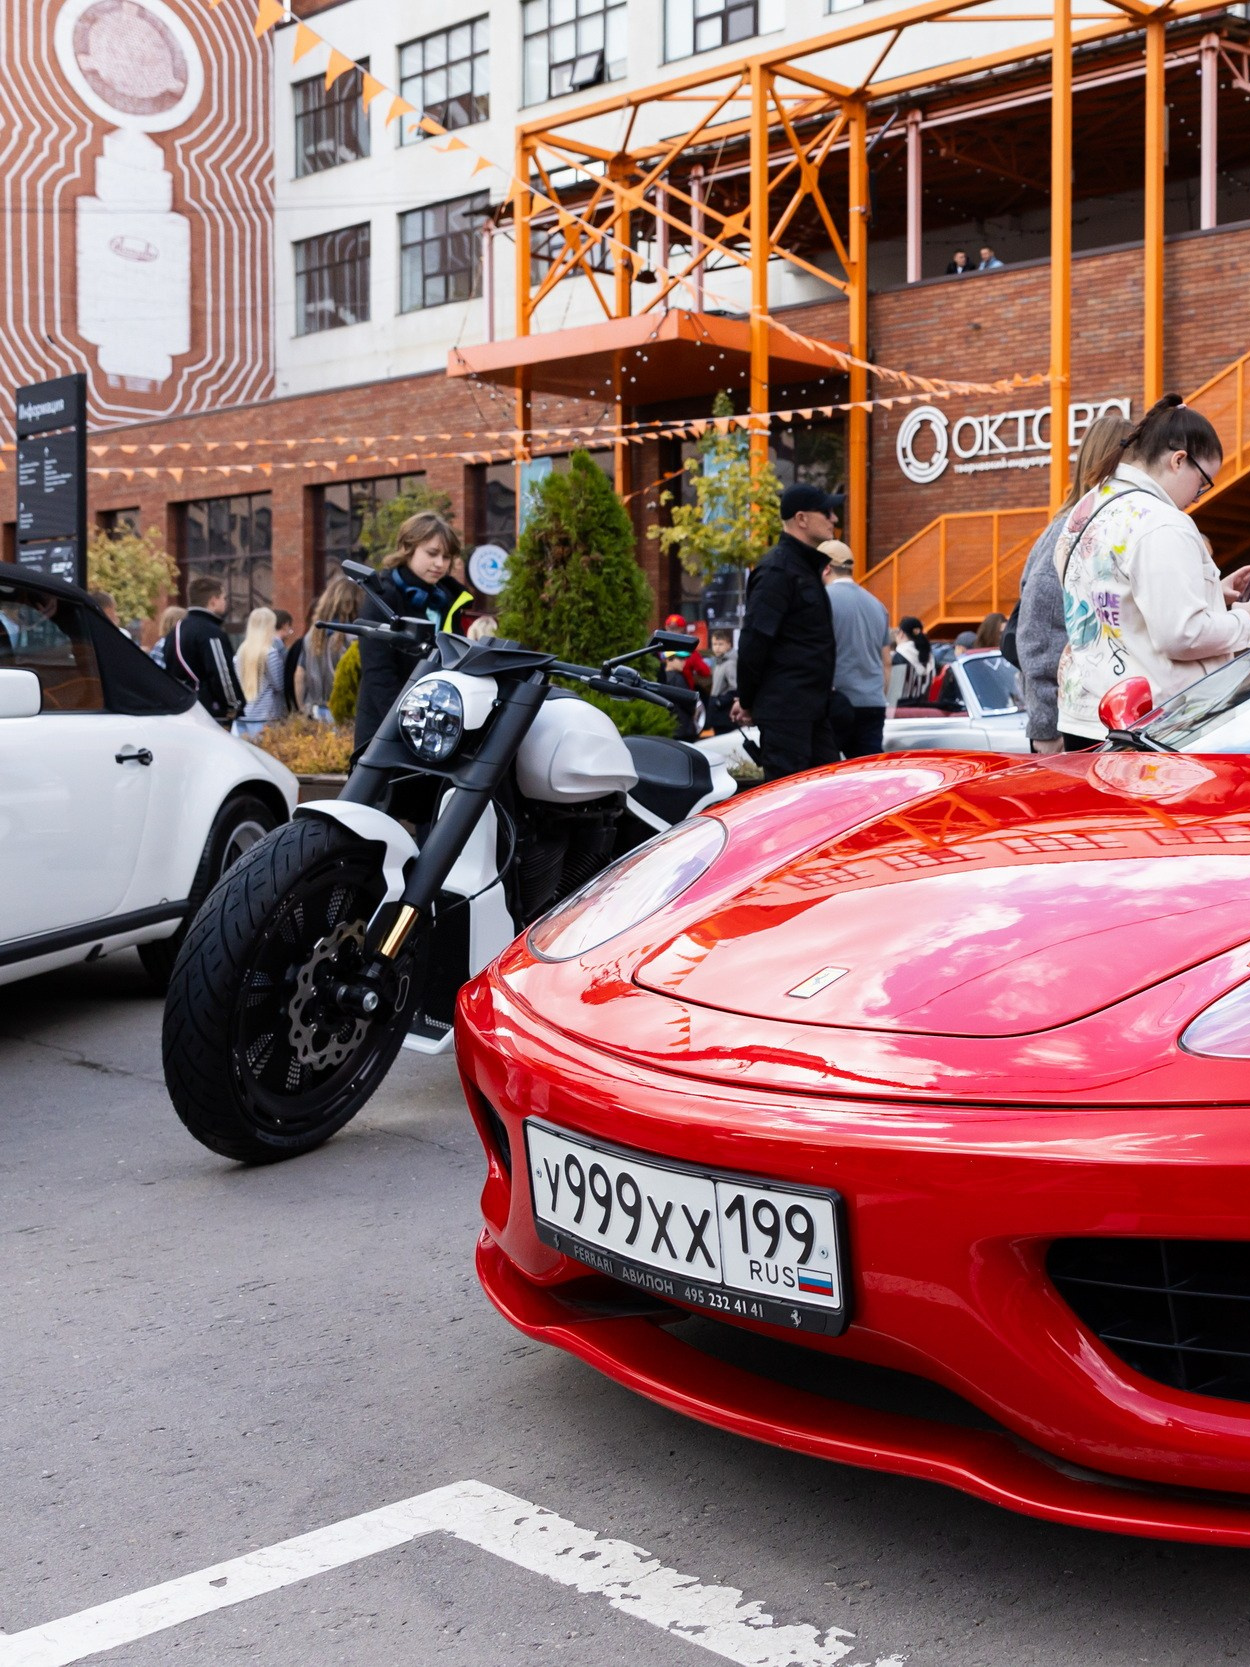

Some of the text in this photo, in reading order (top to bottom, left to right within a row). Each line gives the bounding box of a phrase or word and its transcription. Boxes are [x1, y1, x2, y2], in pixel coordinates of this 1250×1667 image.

[724, 1194, 815, 1265] 199
[573, 1244, 764, 1318] FERRARI АВИЛОН 495 232 41 41
[749, 1259, 796, 1288] RUS
